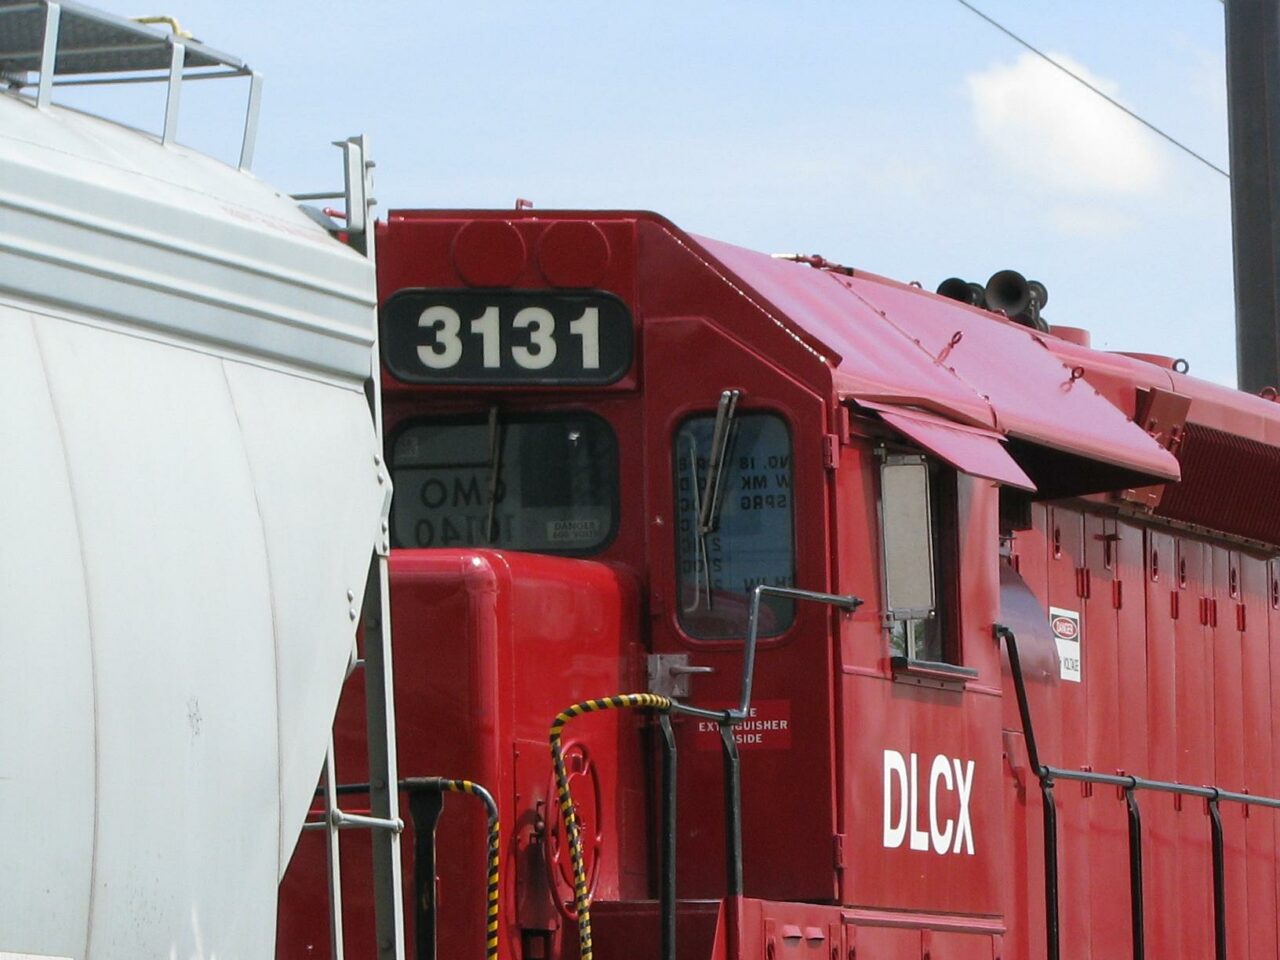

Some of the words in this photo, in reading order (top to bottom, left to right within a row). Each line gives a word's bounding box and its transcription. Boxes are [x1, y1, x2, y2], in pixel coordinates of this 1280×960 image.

[416, 305, 600, 370] 3131
[699, 719, 788, 732] EXTGUISHER
[882, 748, 975, 856] DLCX
